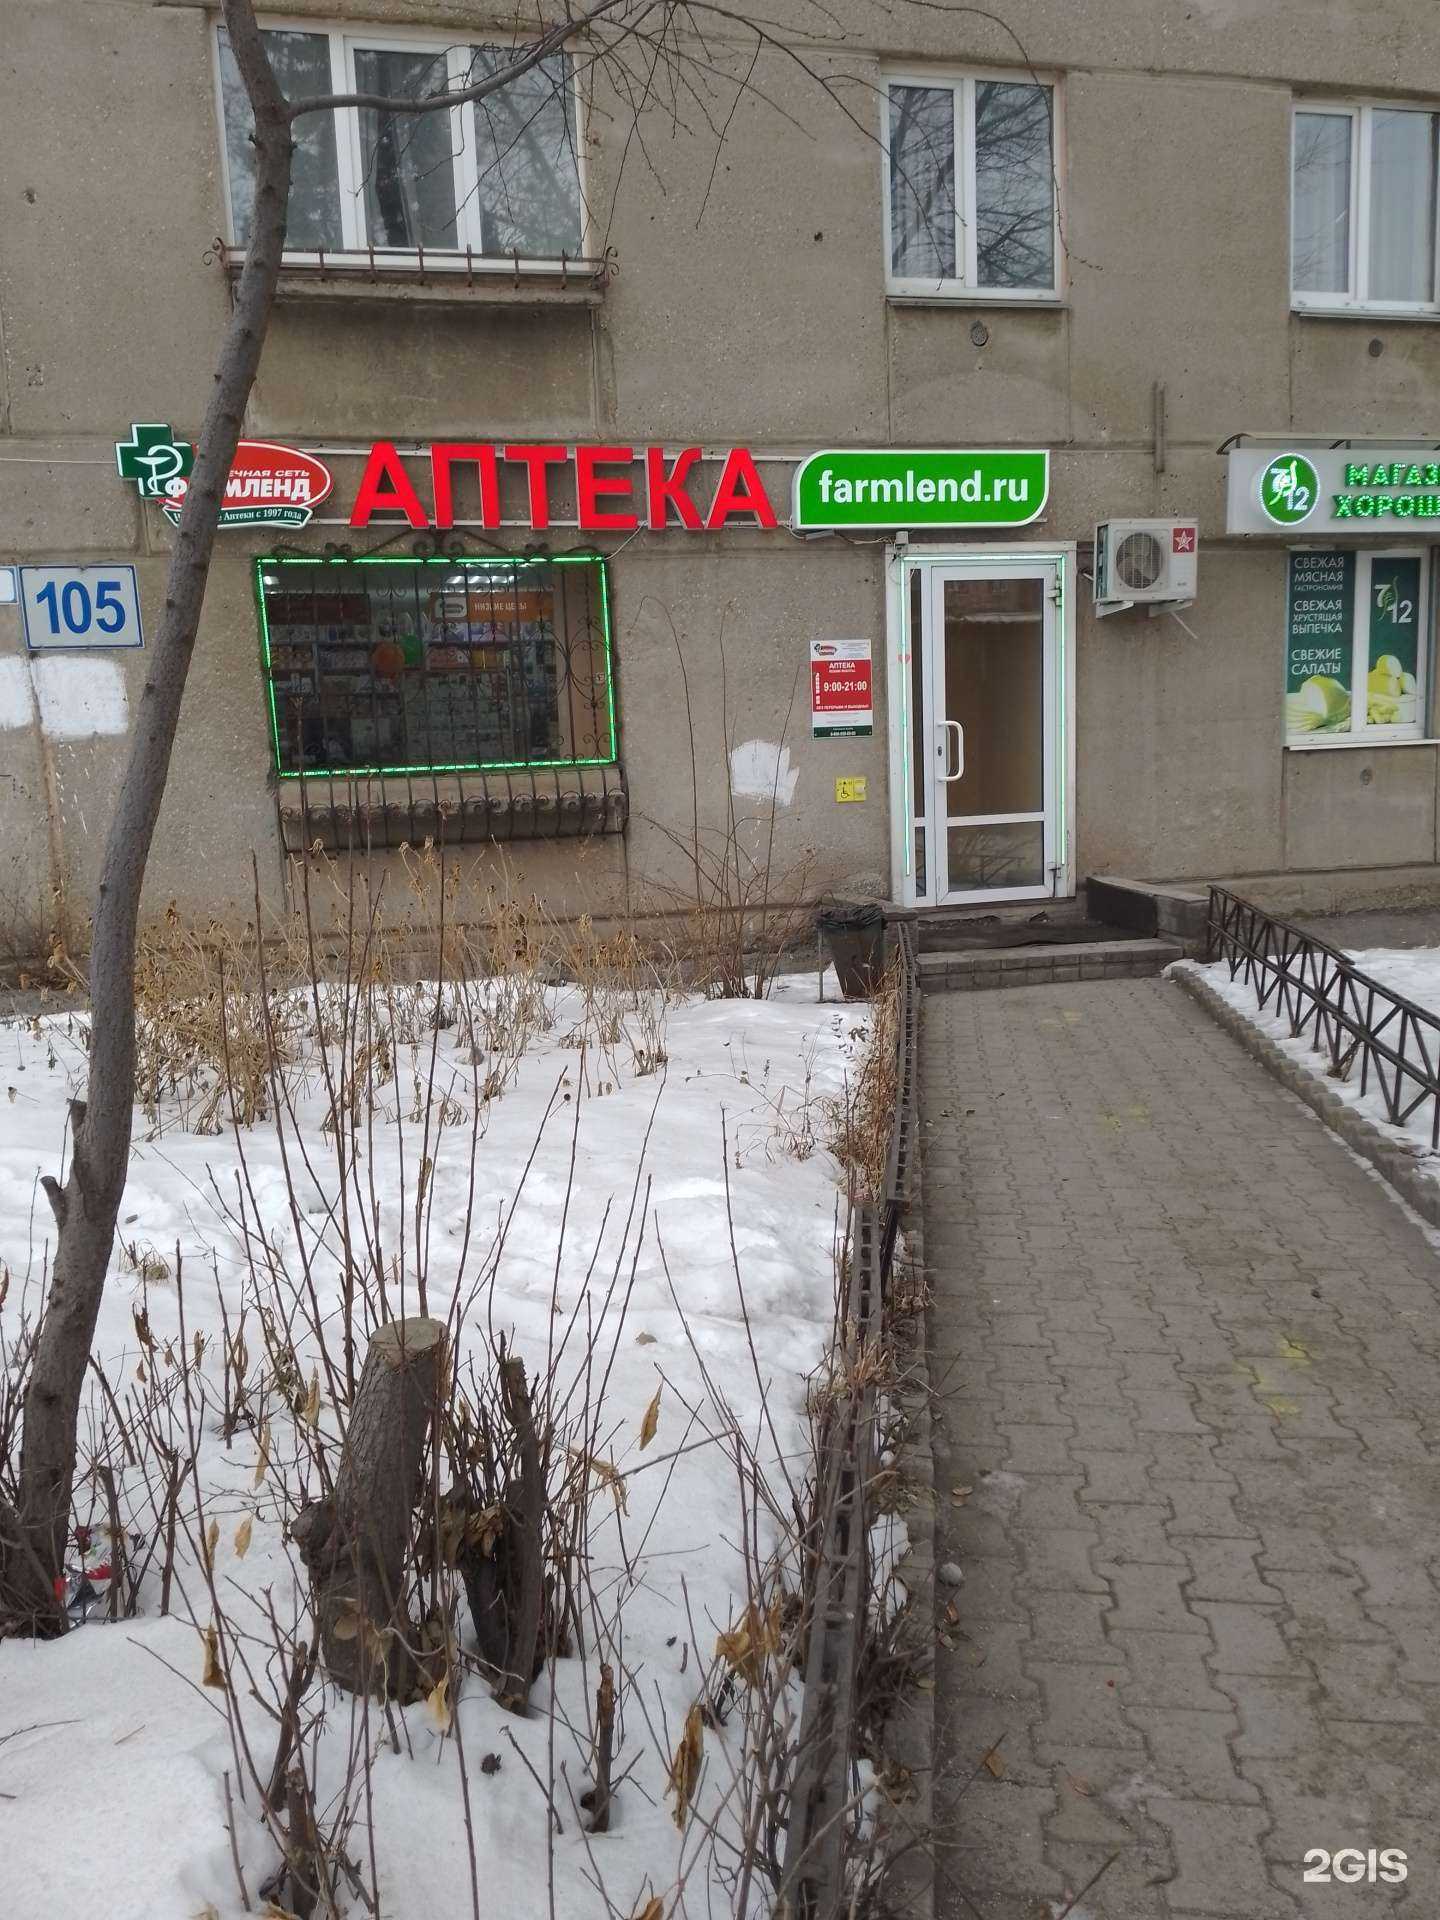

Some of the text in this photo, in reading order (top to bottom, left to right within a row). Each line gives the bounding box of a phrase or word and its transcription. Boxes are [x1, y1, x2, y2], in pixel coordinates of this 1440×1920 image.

[275, 469, 310, 477] СЕТЬ
[1344, 463, 1440, 488] МАГАЗ
[165, 477, 311, 501] ФМЛЕНД
[349, 441, 778, 530] АПТЕКА
[818, 470, 1029, 503] farmlend.ru
[224, 512, 254, 521] Аптеки
[263, 508, 283, 518] 1997
[284, 510, 302, 520] года
[1294, 556, 1345, 569] СВЕЖАЯ
[1294, 571, 1344, 583] МЯСНАЯ
[1374, 584, 1392, 608] 7
[36, 580, 126, 634] 105
[1294, 599, 1342, 611] СВЕЖАЯ
[1387, 599, 1413, 624] 12
[1292, 612, 1343, 622] ХРУСТЯЩАЯ
[1292, 622, 1343, 635] ВЫПЕЧКА
[1291, 648, 1342, 661] СВЕЖИЕ
[829, 661, 856, 669] АПТЕКА
[1291, 662, 1342, 676] САЛАТЫ
[823, 680, 868, 692] 9:00-21:00
